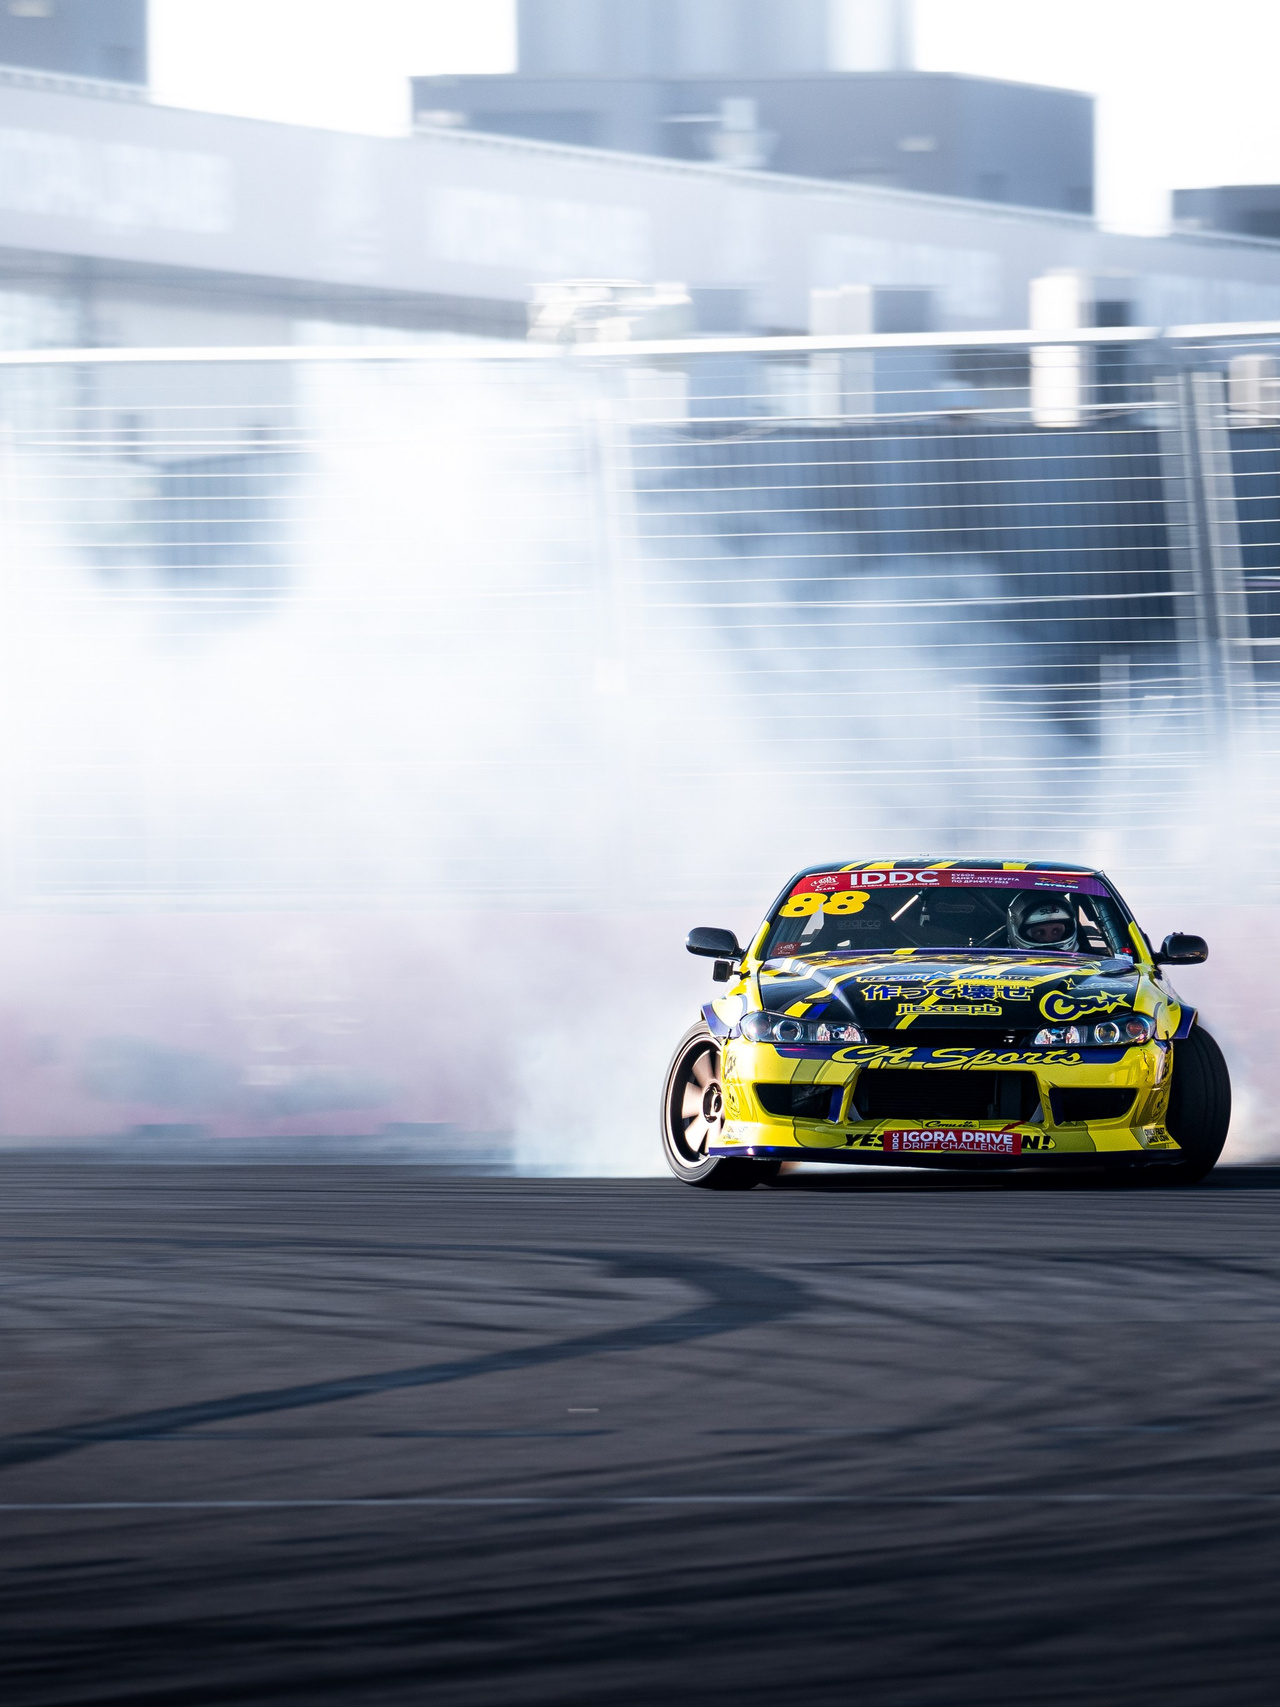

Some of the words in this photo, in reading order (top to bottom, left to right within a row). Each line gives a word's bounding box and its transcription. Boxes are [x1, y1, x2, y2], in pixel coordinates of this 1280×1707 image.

[850, 871, 939, 885] IDDC
[778, 891, 870, 917] 88
[862, 984, 1034, 1001] 作って壊せ
[898, 1003, 1001, 1015] jiexaspb
[922, 1048, 1084, 1070] Sports
[902, 1131, 957, 1143] IGORA
[962, 1132, 1013, 1145] DRIVE
[902, 1141, 938, 1150] DRIFT
[941, 1141, 1013, 1153] CHALLENGE
